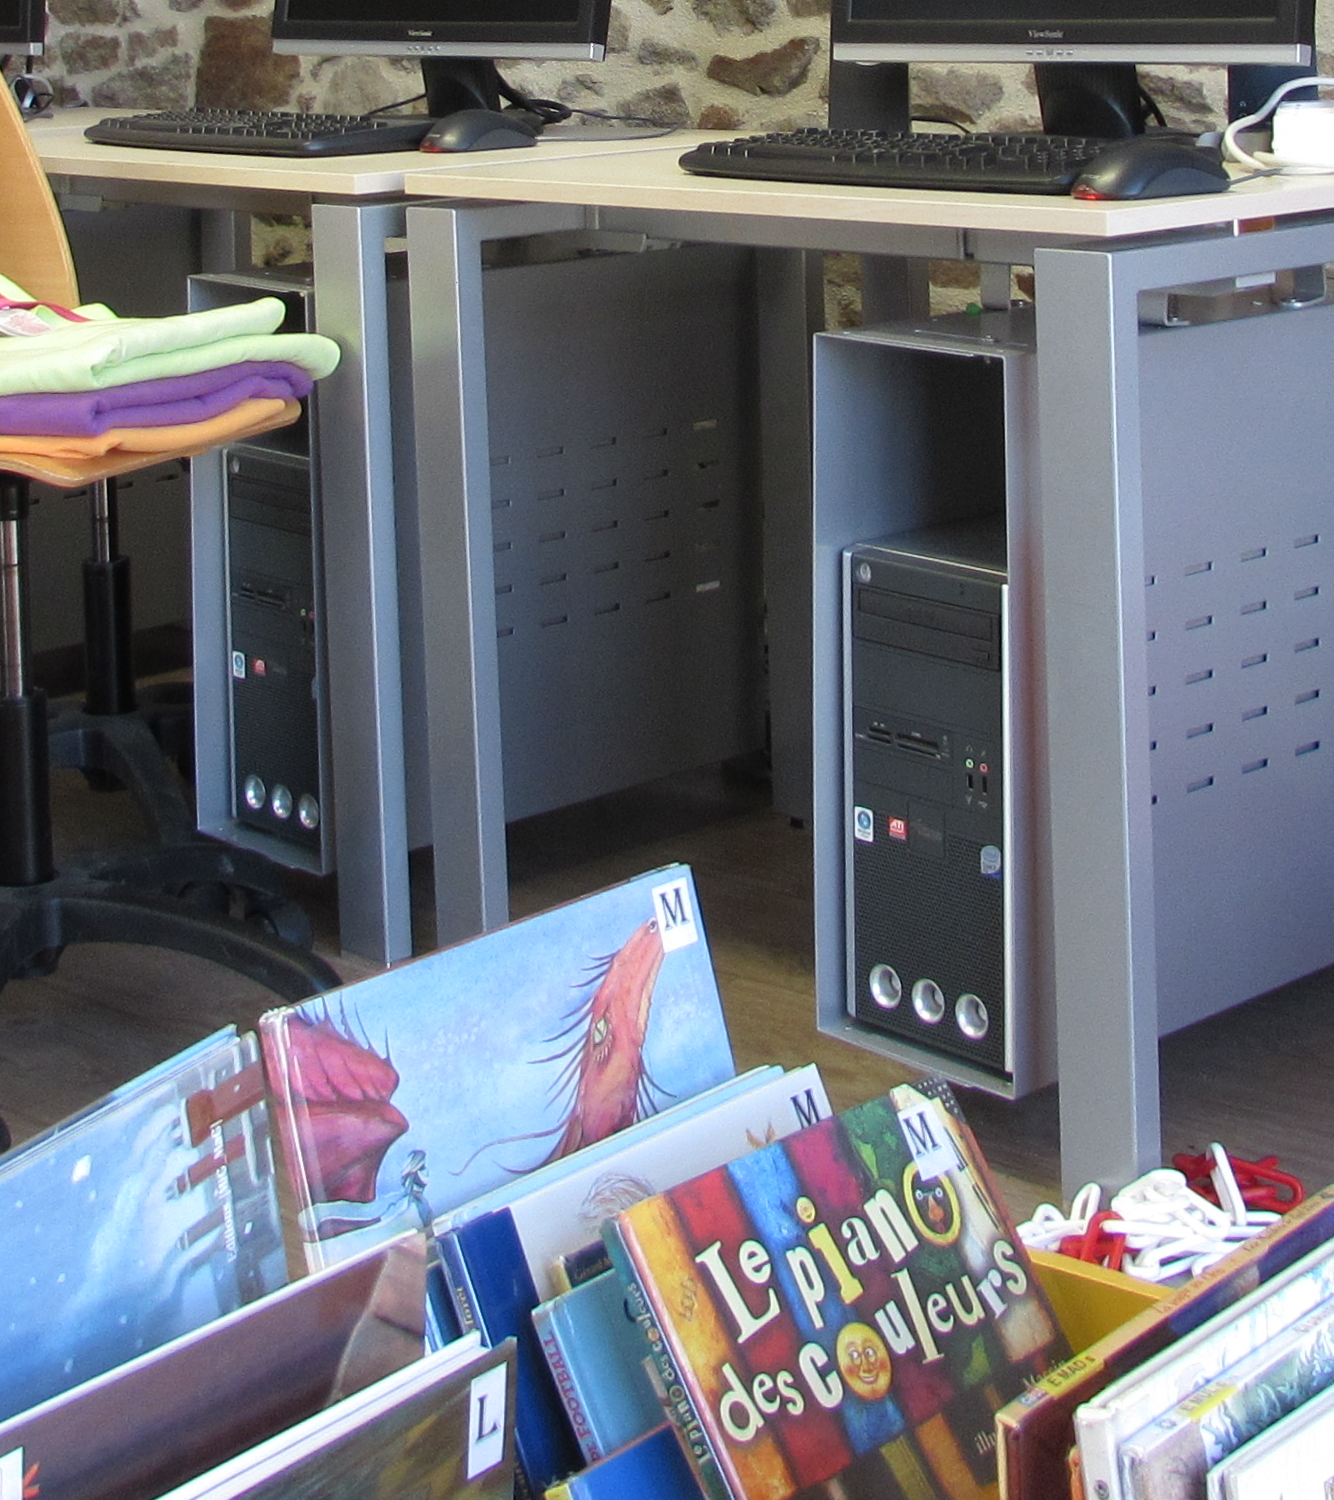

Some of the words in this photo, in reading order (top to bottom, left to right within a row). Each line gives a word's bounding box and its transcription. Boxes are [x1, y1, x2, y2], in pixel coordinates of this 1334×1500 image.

[659, 887, 690, 932] M
[902, 1110, 943, 1156] M
[695, 1239, 782, 1344] Le
[544, 1329, 592, 1440] FOOTBALL
[659, 1353, 676, 1383] des
[476, 1393, 501, 1443] L
[720, 1362, 806, 1443] des
